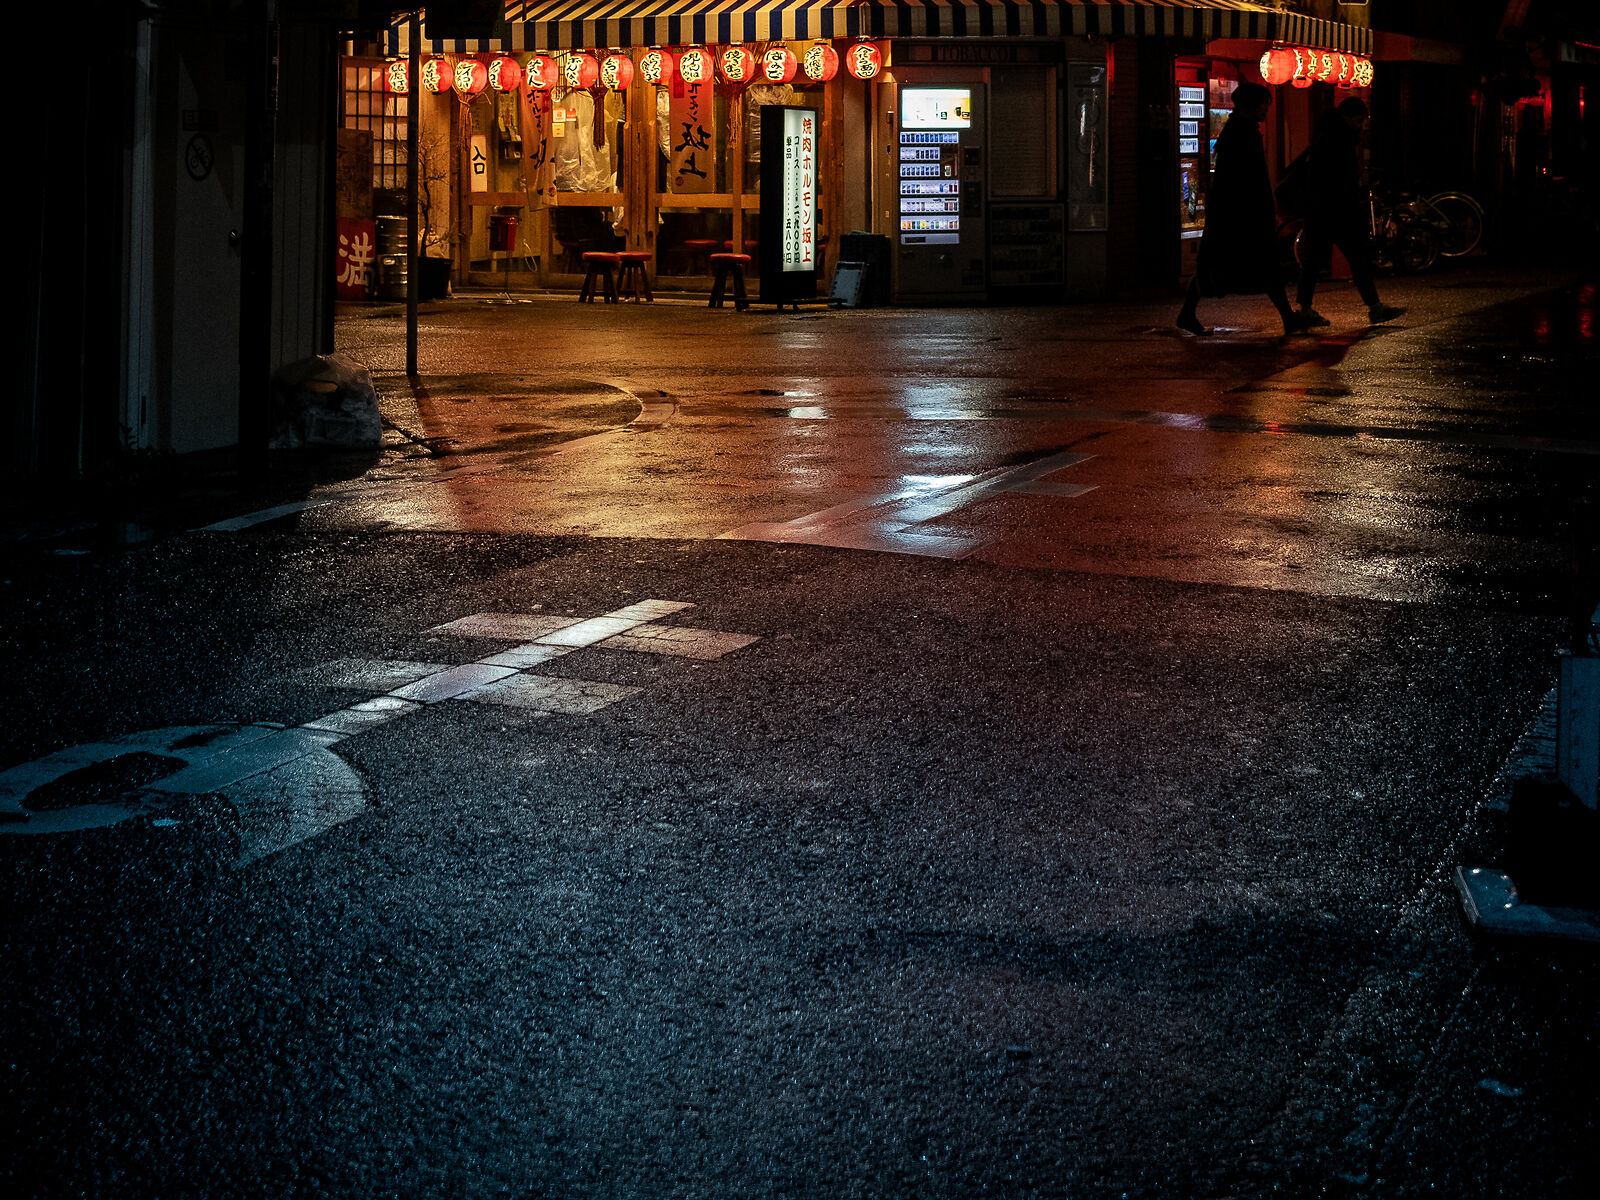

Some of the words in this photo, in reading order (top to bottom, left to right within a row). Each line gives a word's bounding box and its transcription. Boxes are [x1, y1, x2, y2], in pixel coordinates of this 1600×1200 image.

[941, 45, 1010, 62] TOBACCO
[527, 59, 545, 87] 芸人
[472, 145, 487, 175] 入口
[802, 117, 812, 263] 焼肉ホルモン坂上
